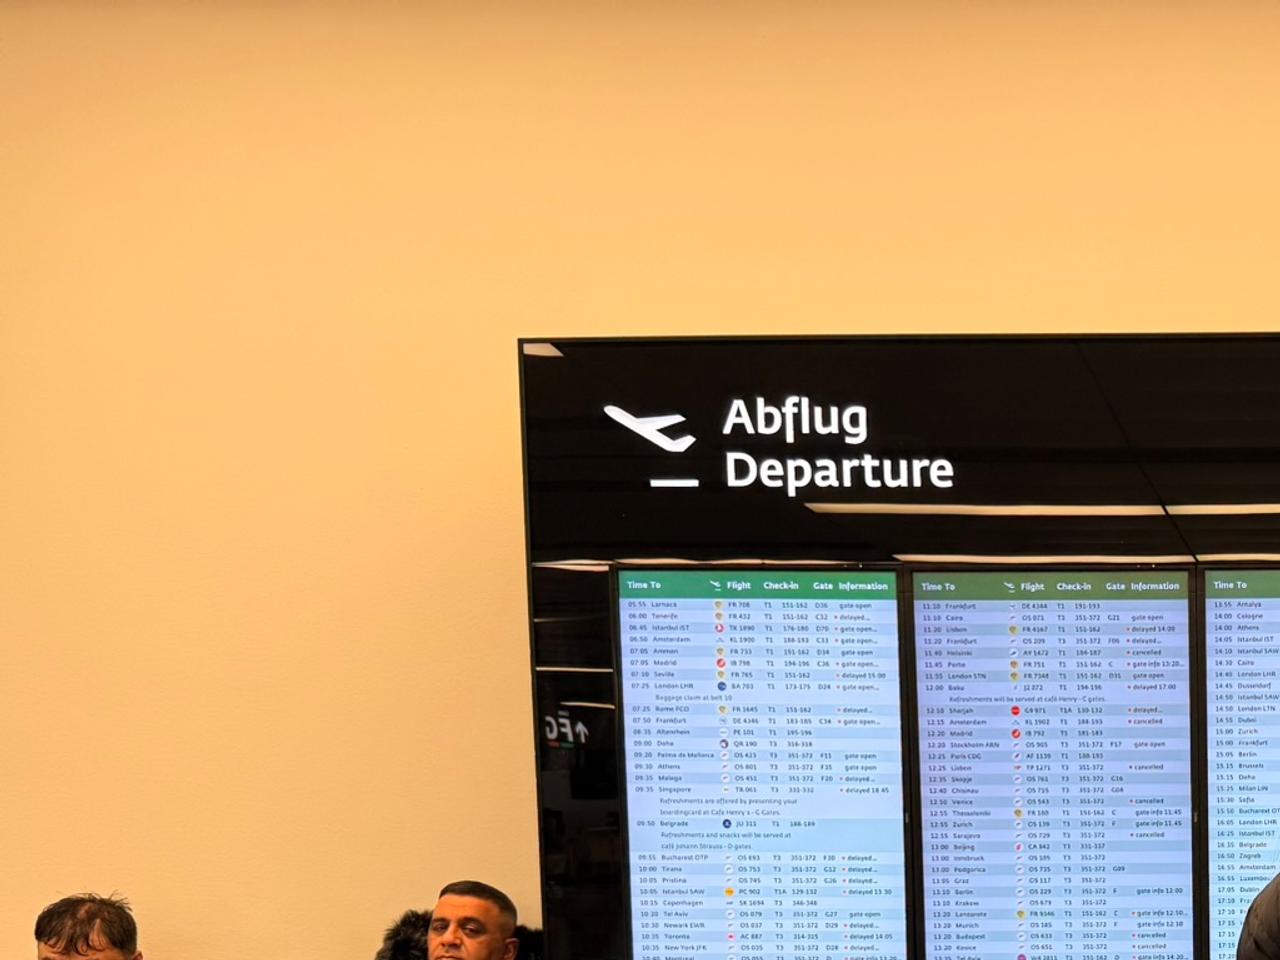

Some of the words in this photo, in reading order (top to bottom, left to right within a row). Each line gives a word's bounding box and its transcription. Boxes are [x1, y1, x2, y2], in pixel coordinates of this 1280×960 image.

[723, 397, 868, 444] Abflug
[725, 453, 954, 496] Departure
[626, 580, 648, 589] Time
[650, 580, 662, 589] To
[726, 581, 752, 592] Flight
[762, 580, 799, 590] Check-in
[812, 581, 834, 590] Gate
[838, 581, 888, 592] Information
[921, 582, 942, 591] Time
[944, 582, 956, 591] To
[1020, 582, 1046, 593] Flight
[1056, 582, 1092, 591] Check-in
[1106, 582, 1126, 591] Gate
[1130, 581, 1180, 592] Information
[1214, 580, 1234, 589] Time
[1236, 581, 1248, 589] To
[839, 602, 854, 611] gate
[855, 602, 873, 611] open
[1131, 614, 1146, 623] gate
[1147, 614, 1164, 623] open
[1132, 625, 1156, 634] delayed
[840, 649, 856, 658] gate
[857, 650, 874, 658] open
[1132, 648, 1162, 657] cancelled
[841, 671, 866, 681] delayed
[1132, 671, 1147, 681] gate
[1148, 672, 1164, 681] open
[1133, 717, 1164, 725] cancelled
[843, 751, 859, 761] gate
[860, 753, 877, 761] open
[1134, 763, 1164, 771] cancelled
[845, 786, 870, 795] delayed
[1134, 797, 1164, 805] cancelled
[1135, 831, 1166, 839] cancelled
[1137, 931, 1166, 939] cancelled
[1137, 942, 1166, 950] cancelled
